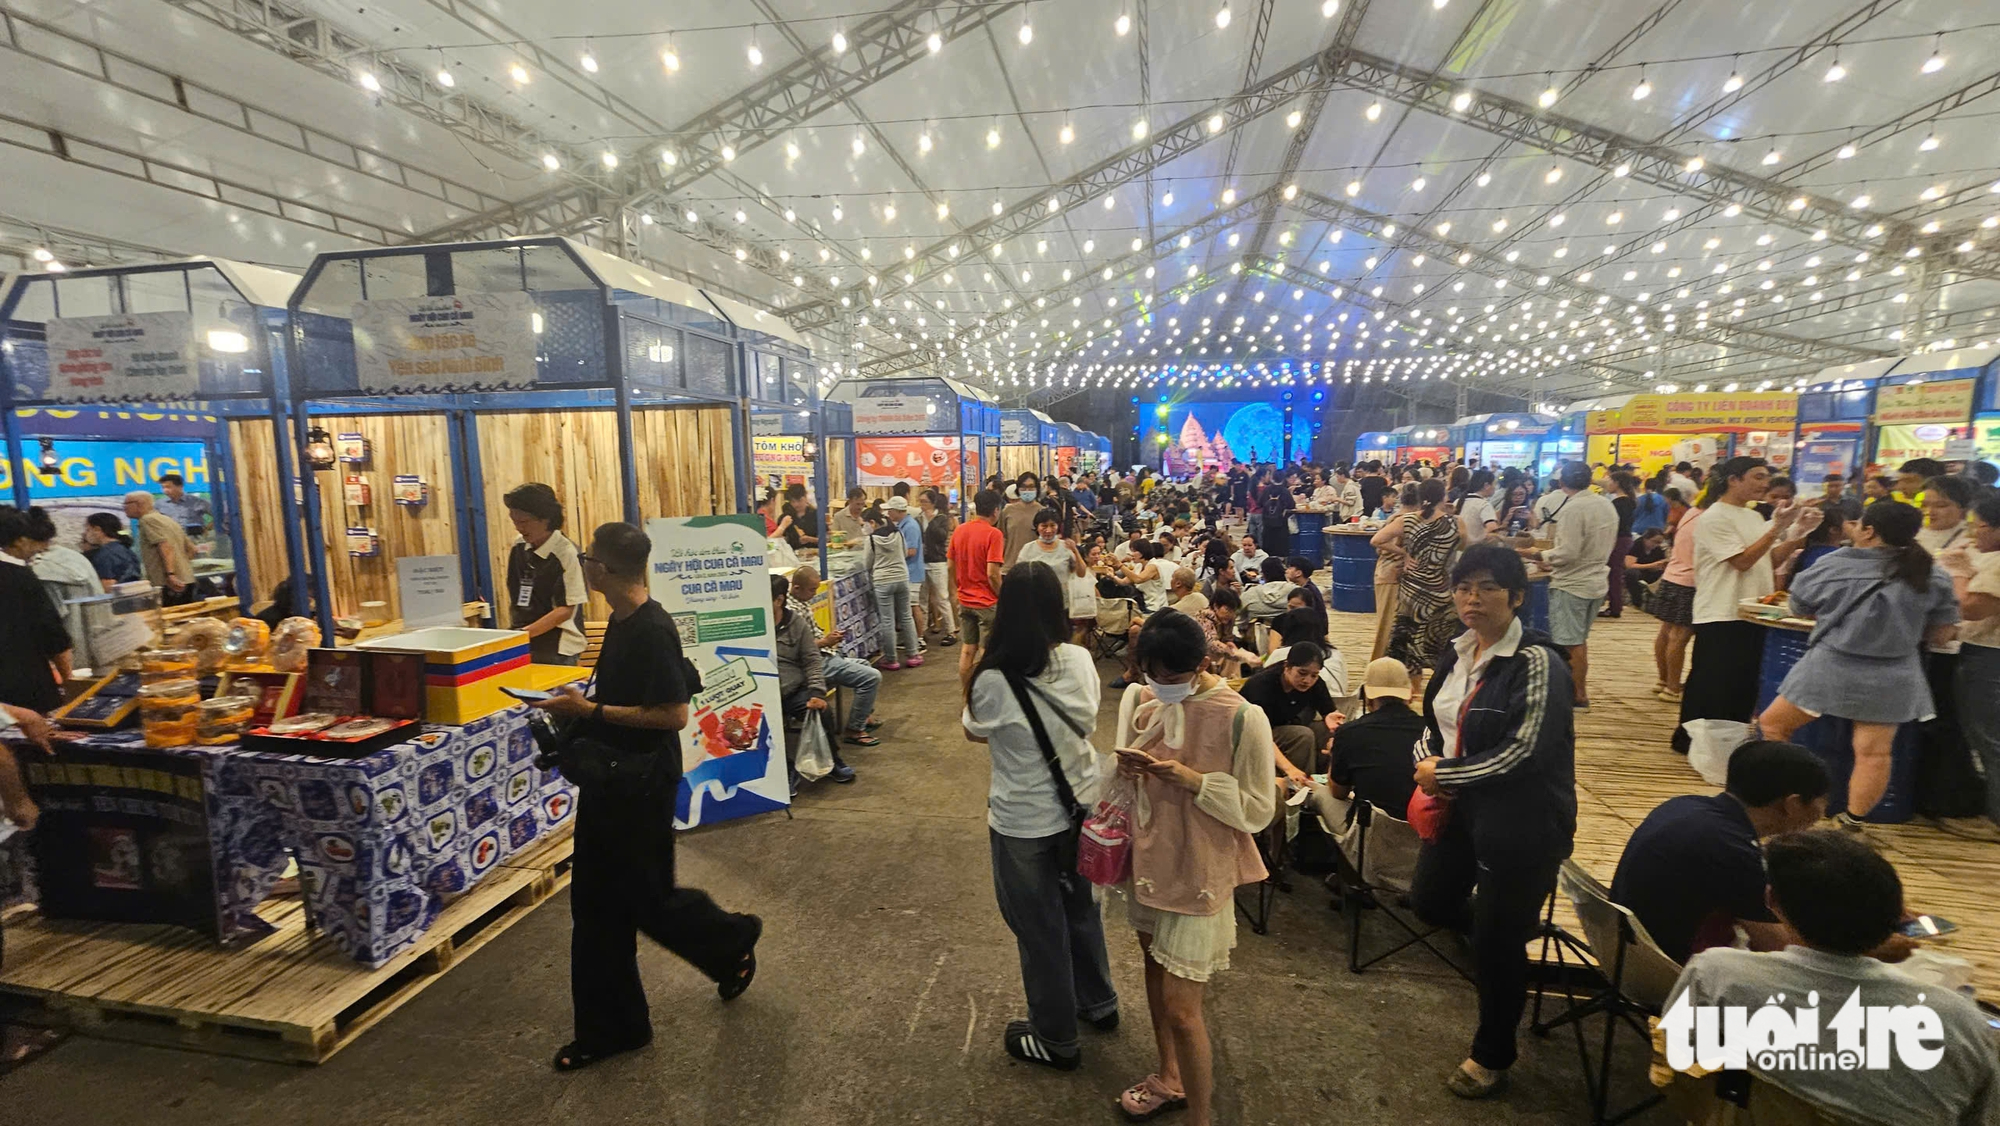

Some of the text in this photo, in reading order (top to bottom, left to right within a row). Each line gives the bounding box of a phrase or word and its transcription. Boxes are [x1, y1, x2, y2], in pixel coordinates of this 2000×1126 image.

[654, 555, 764, 574] NGÀY HỘI CUA CÀ MAU
[681, 580, 743, 595] CUA CÀ MAU
